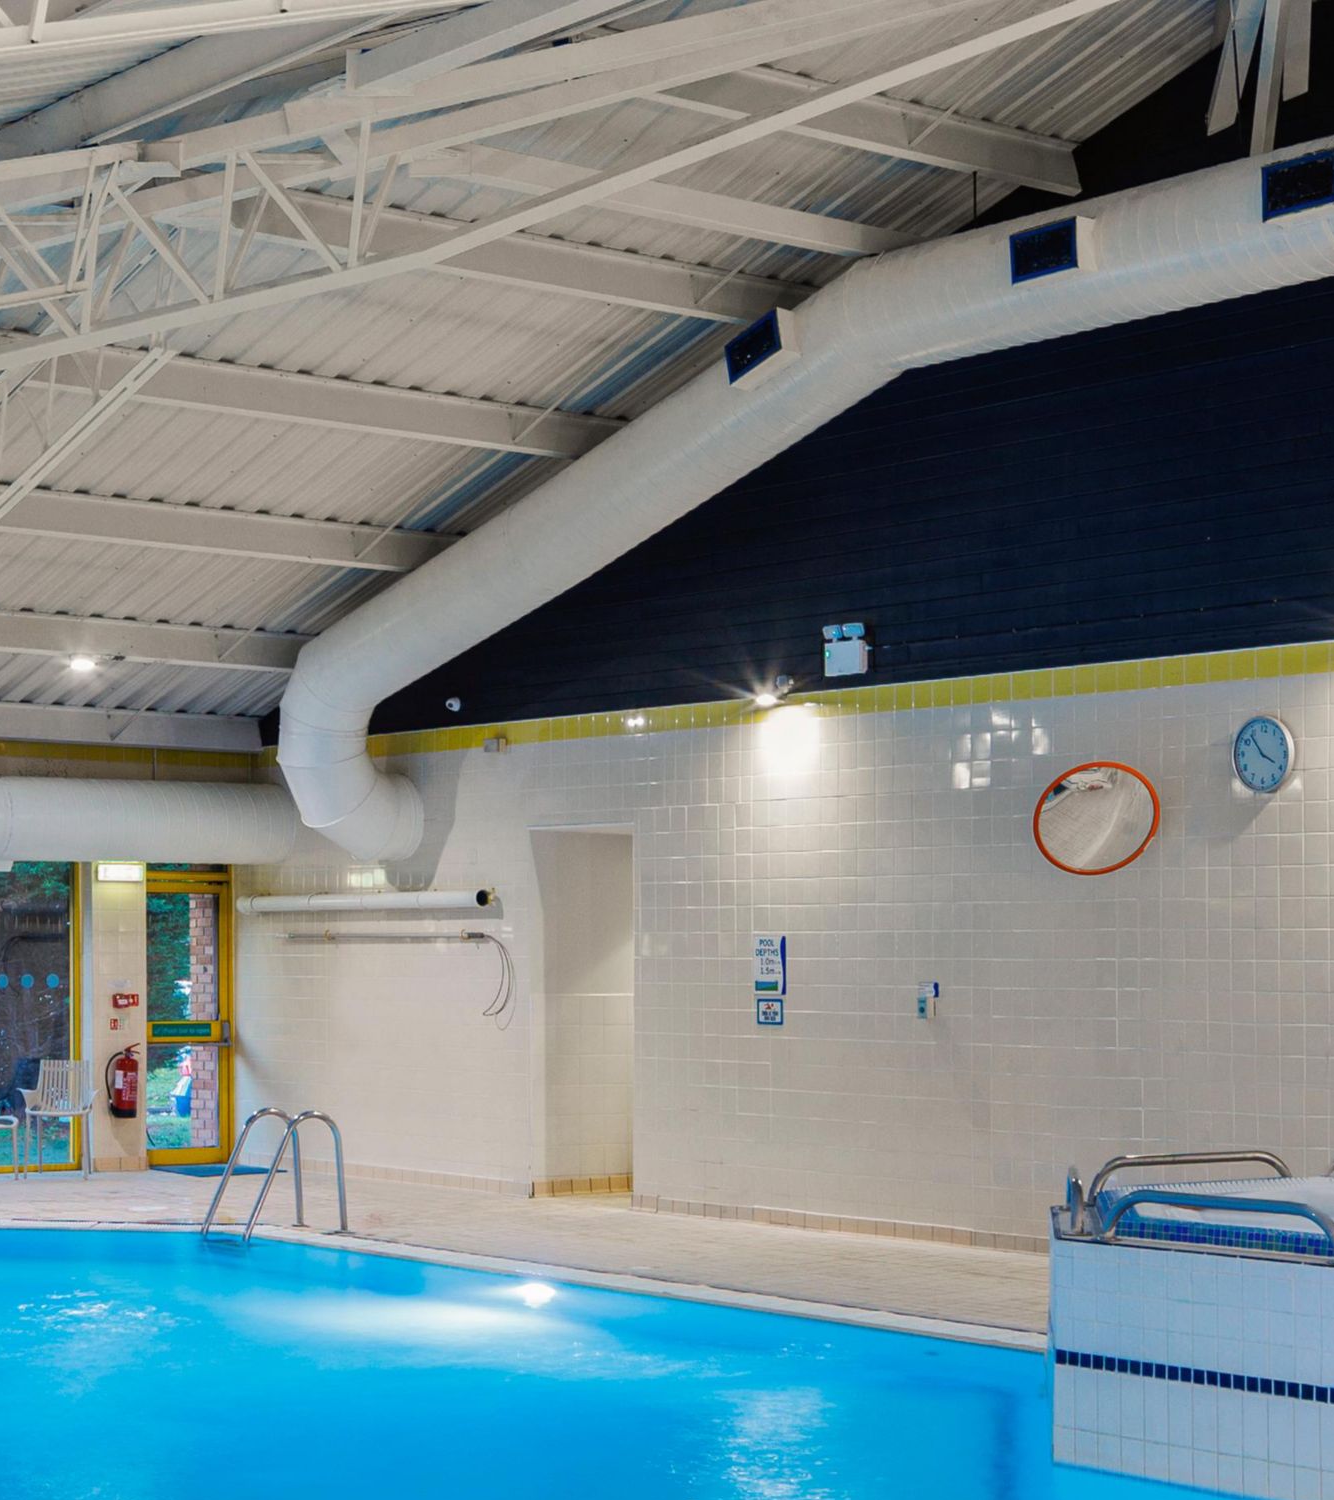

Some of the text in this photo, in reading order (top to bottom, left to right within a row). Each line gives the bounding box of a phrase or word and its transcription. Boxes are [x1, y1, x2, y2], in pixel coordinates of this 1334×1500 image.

[1261, 725, 1268, 733] 12
[759, 939, 774, 947] POOL
[755, 948, 779, 957] DEPTHS
